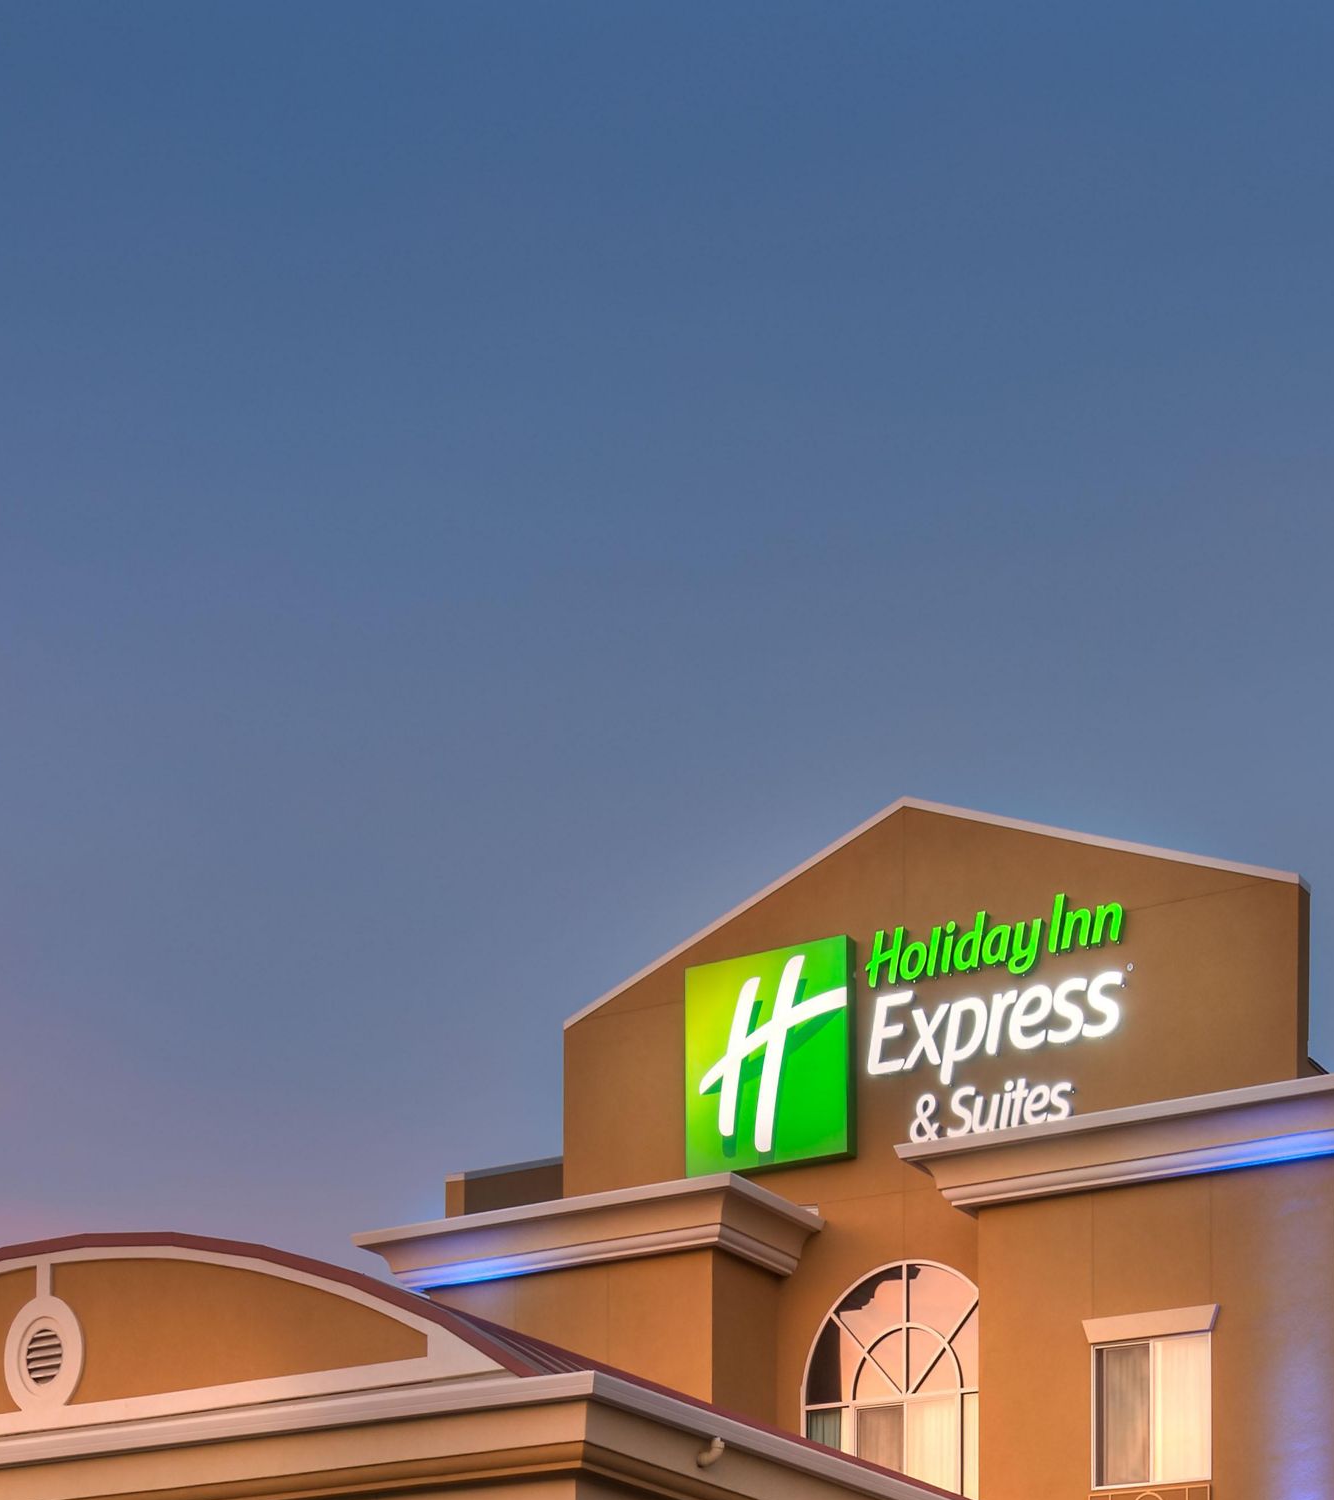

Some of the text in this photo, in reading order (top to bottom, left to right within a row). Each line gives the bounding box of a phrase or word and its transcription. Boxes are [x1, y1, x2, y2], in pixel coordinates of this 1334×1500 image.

[865, 893, 1123, 988] Holiday Inn
[868, 971, 1123, 1084] Express
[910, 1078, 1071, 1143] & Suites
